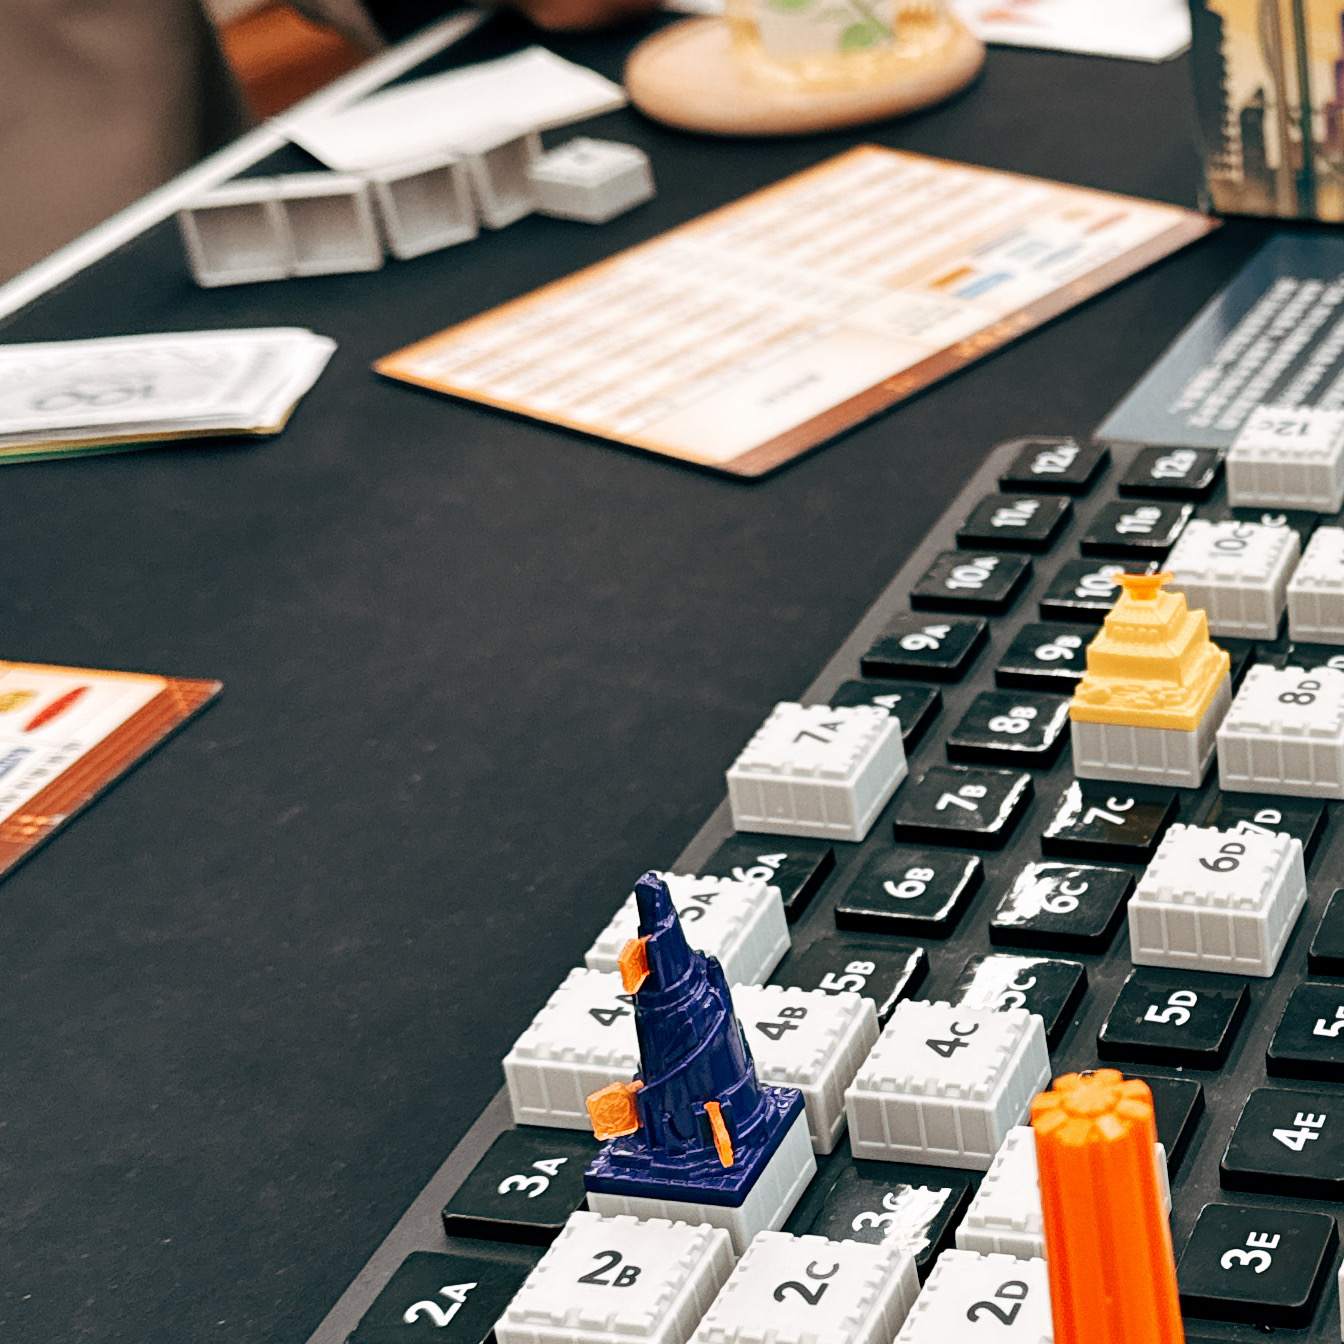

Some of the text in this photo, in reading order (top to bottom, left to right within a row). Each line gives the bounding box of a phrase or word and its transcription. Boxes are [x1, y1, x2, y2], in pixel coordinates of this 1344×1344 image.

[1031, 443, 1080, 474] 12A
[1151, 449, 1197, 478] 12B
[991, 499, 1039, 527] 11A
[1116, 506, 1161, 533] 11B
[1209, 527, 1254, 557] 10C
[945, 556, 998, 589] 10A
[1075, 565, 1124, 597] 10B
[900, 624, 951, 650] 9A
[1035, 635, 1082, 660] 9B
[1278, 679, 1321, 705] 8D
[794, 720, 845, 744] 7A
[988, 706, 1038, 734] 8B
[935, 784, 987, 812] 7B
[1082, 797, 1135, 825] 7C
[1235, 809, 1282, 836] 7D
[732, 853, 788, 883] 6A
[1199, 842, 1246, 873] 6D
[883, 867, 935, 899] 6B
[1041, 879, 1089, 914] 6C
[820, 960, 876, 993] 5B
[756, 1006, 807, 1041] 4B
[1144, 990, 1198, 1026] 5D
[925, 1021, 979, 1058] 4C
[1272, 1112, 1327, 1152] 4E
[497, 1154, 569, 1199] 3A
[1220, 1231, 1281, 1274] 3E
[577, 1250, 642, 1289] 2B
[772, 1260, 841, 1307] 2C
[402, 1281, 479, 1329] 2A
[966, 1279, 1029, 1326] 2D
